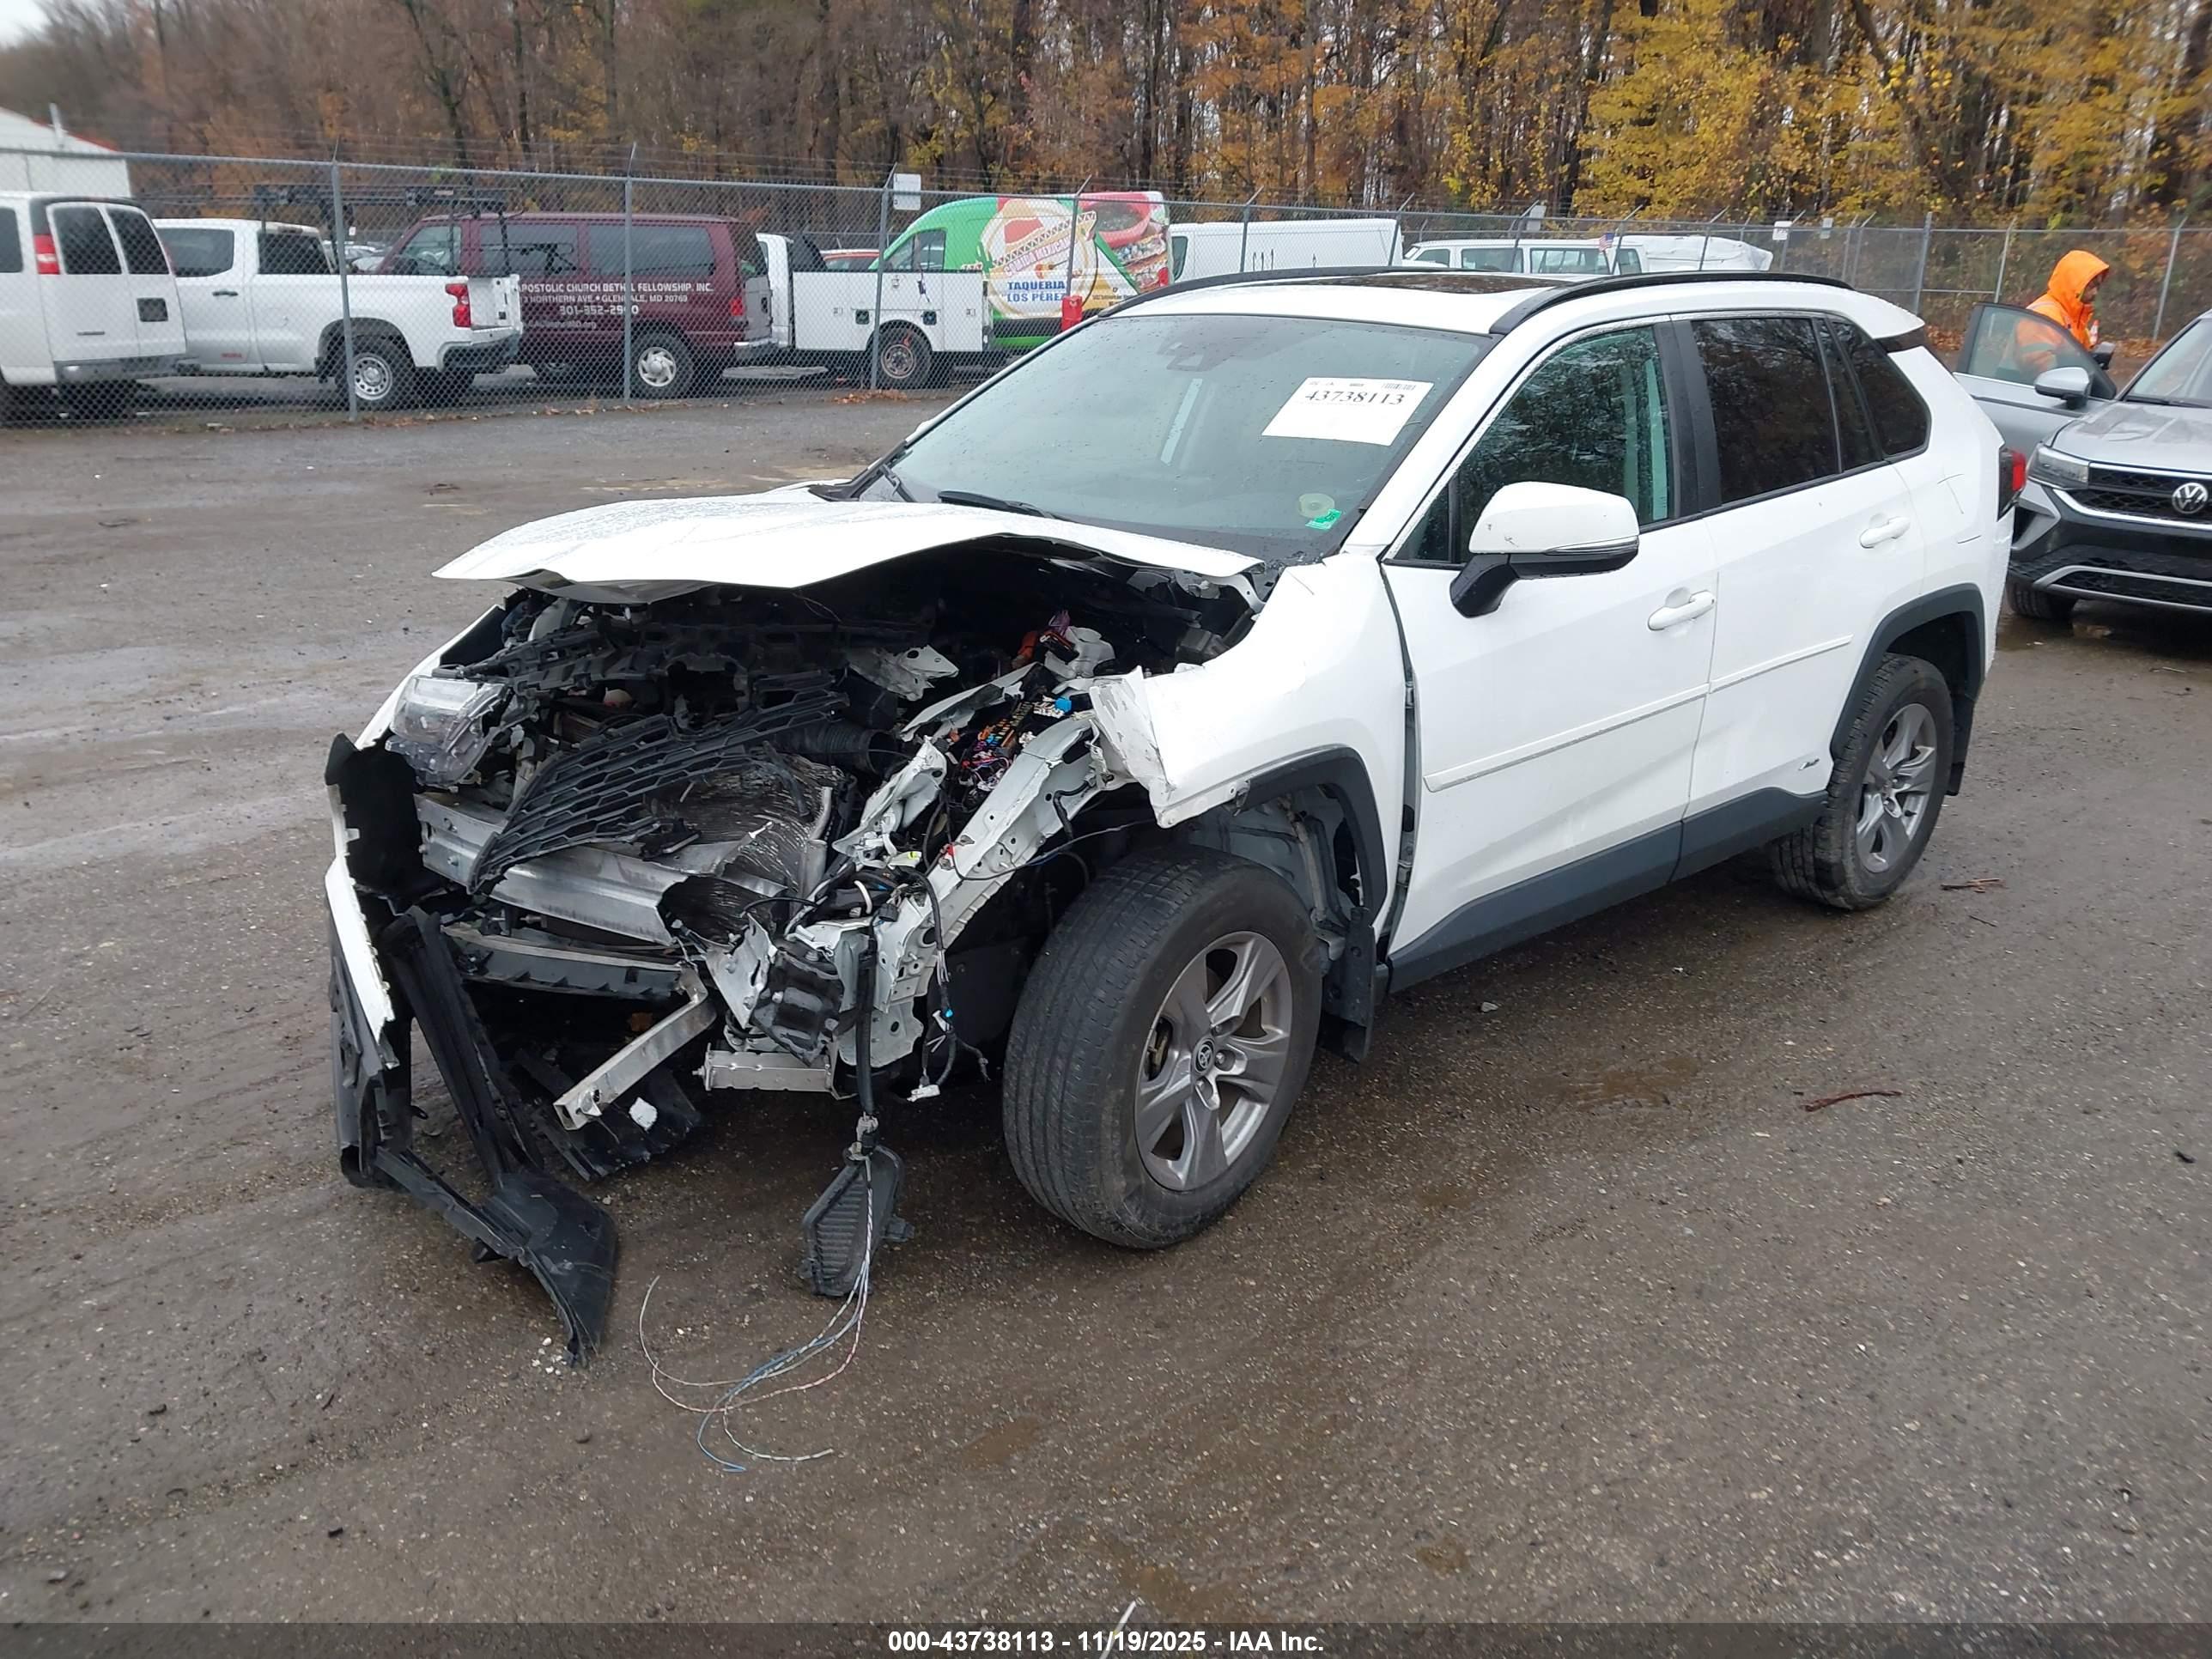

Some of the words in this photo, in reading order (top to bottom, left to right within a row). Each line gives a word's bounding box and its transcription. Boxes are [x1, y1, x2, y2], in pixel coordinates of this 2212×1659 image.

[566, 283, 600, 293] CHURCH
[603, 283, 635, 293] BETHL
[1007, 280, 1066, 290] TAQUERIA
[531, 295, 574, 303] NORTHERN
[601, 295, 647, 304] GLENALE,
[1007, 292, 1029, 302] LOS
[559, 305, 639, 315] 301-352-290
[1305, 390, 1405, 404] 43738113
